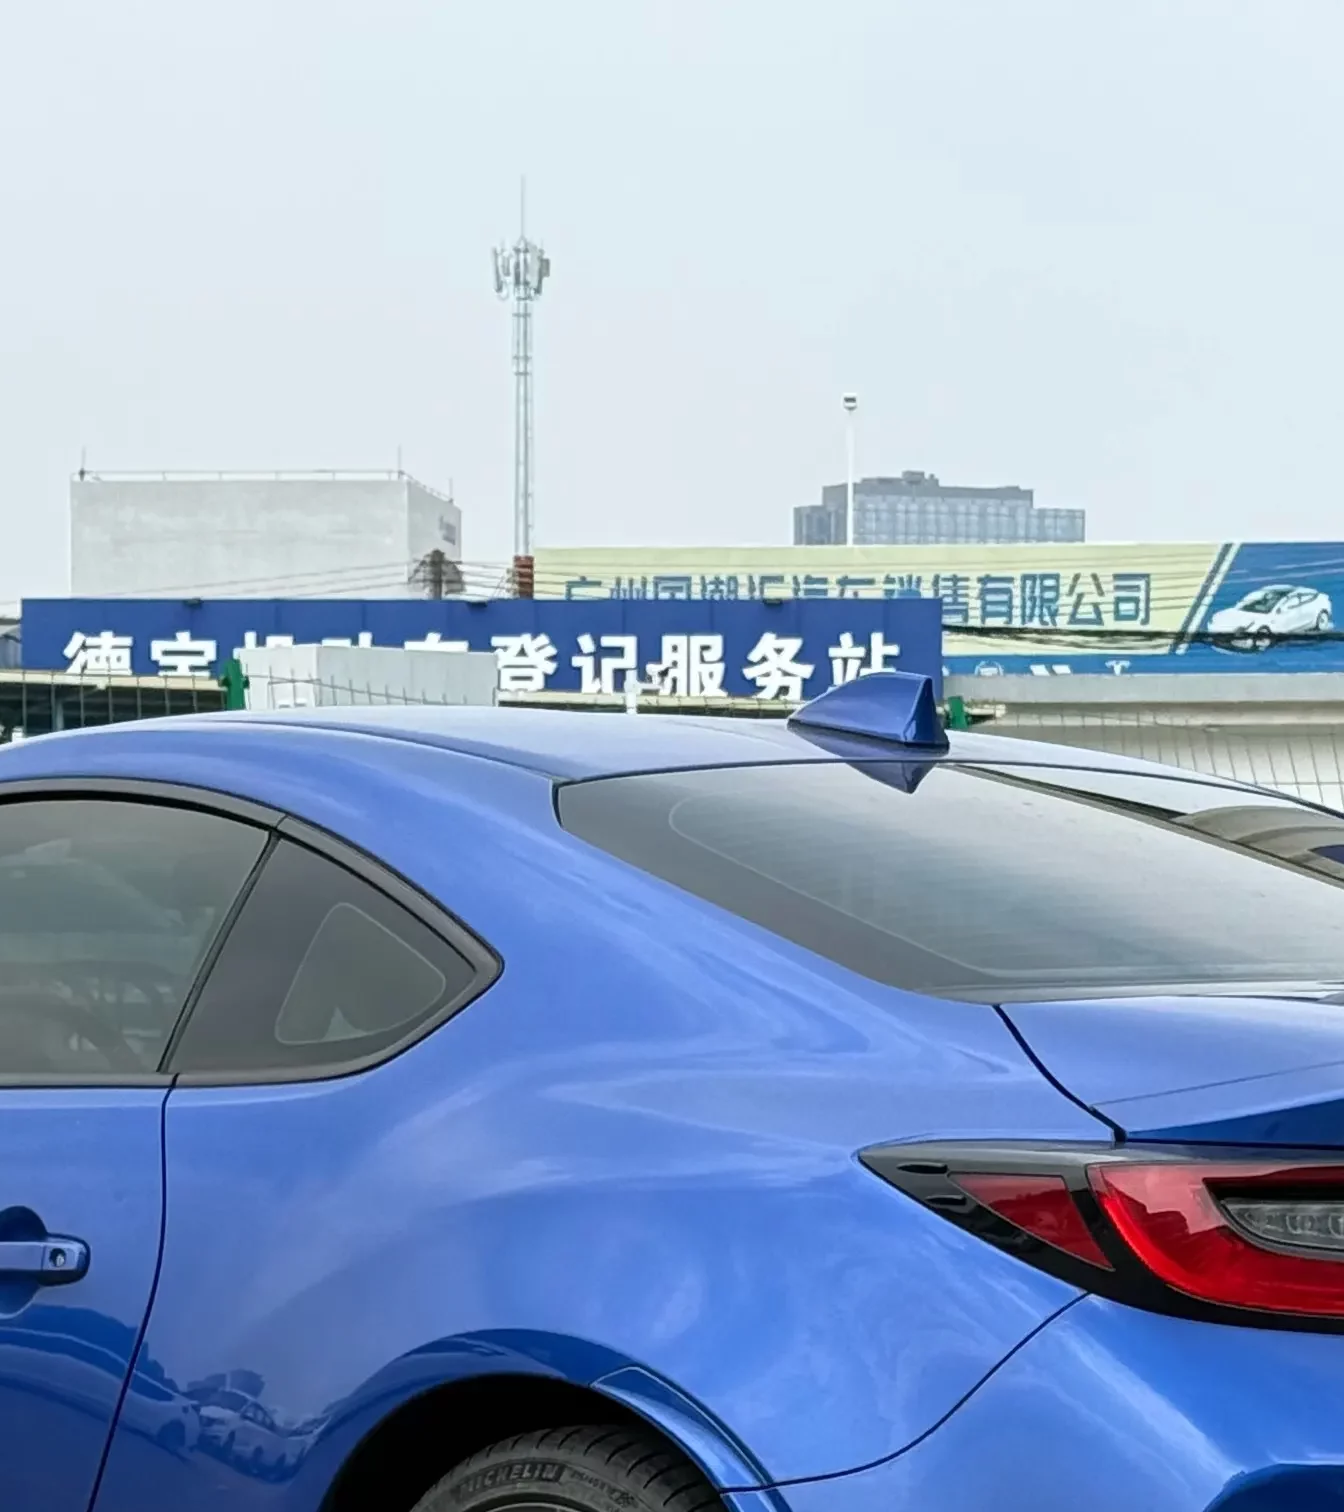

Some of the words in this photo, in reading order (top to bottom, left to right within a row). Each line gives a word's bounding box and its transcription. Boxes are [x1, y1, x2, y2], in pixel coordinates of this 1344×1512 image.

[63, 632, 900, 700] 德宝登记服务站
[459, 1463, 559, 1493] MICHELIN
